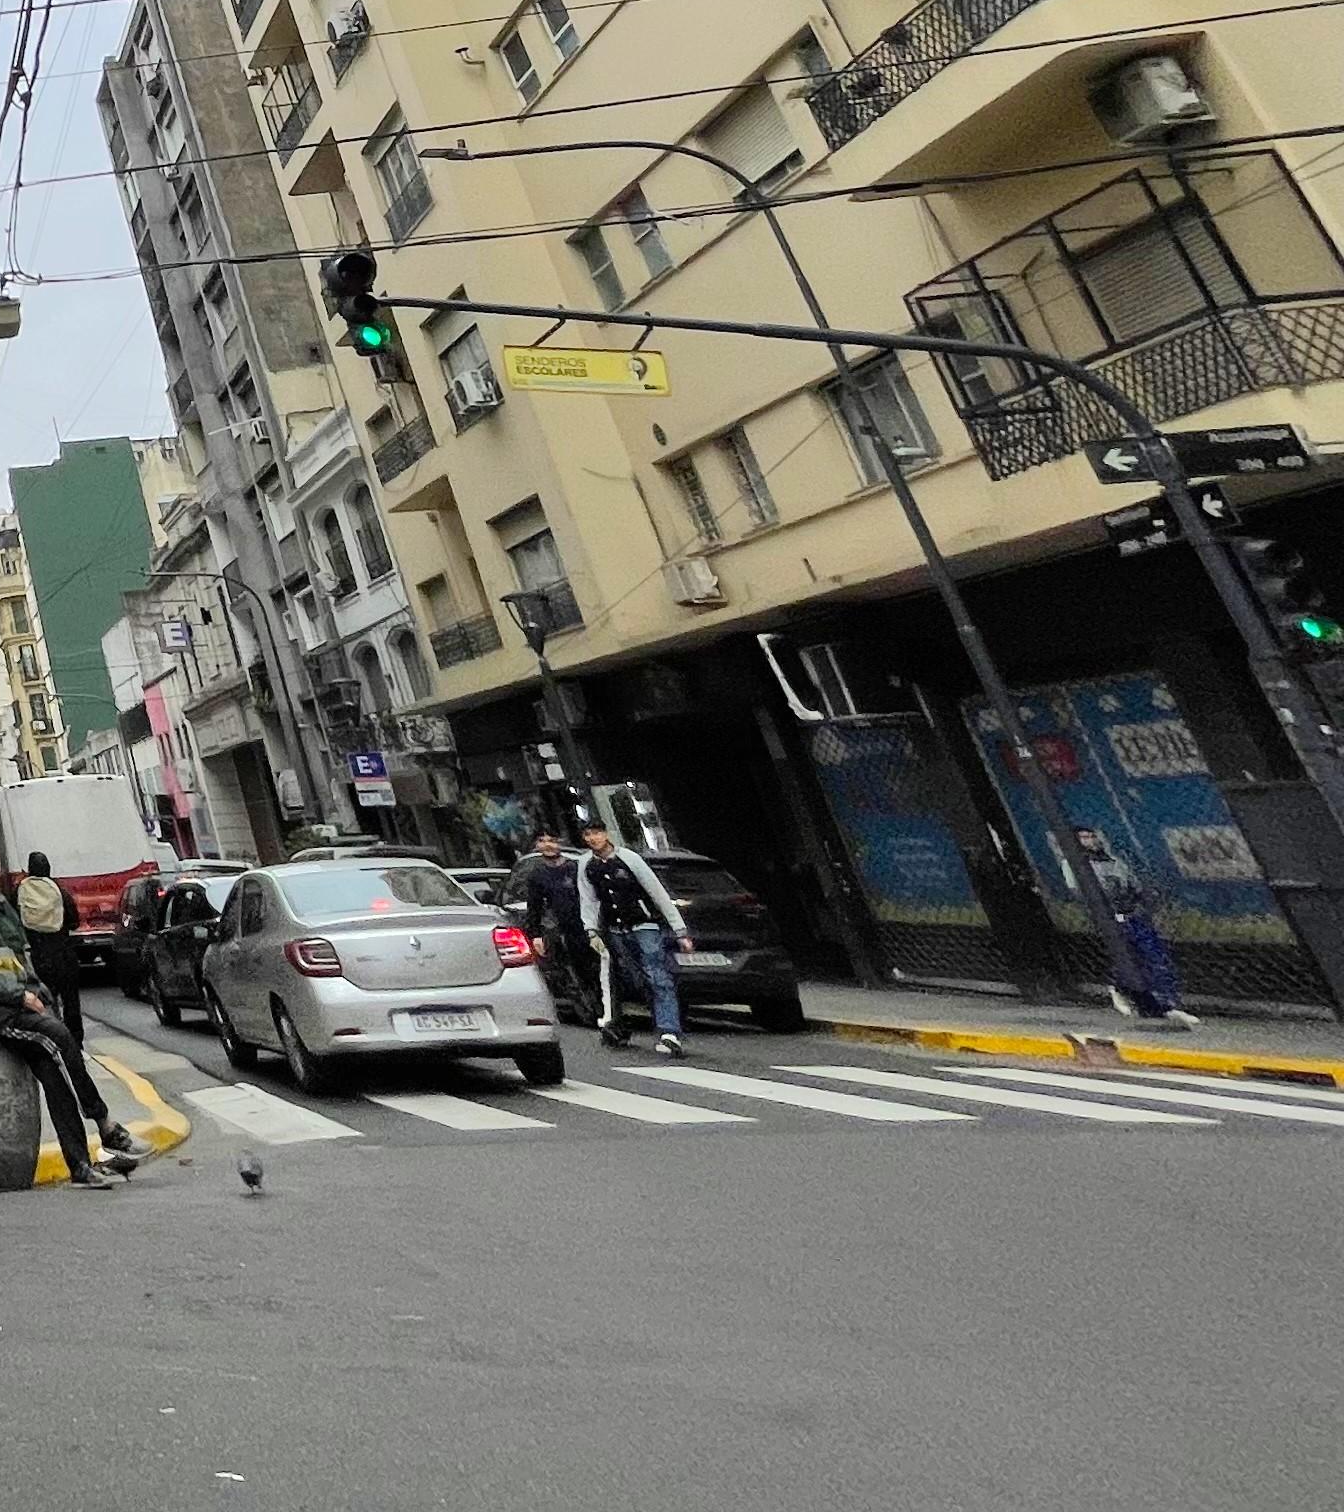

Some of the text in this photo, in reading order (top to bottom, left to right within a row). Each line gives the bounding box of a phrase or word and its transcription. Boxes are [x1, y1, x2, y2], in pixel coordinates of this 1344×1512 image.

[514, 355, 587, 368] SENDEROS
[516, 365, 588, 377] ESCOLARES
[164, 622, 188, 646] E
[355, 755, 373, 774] E
